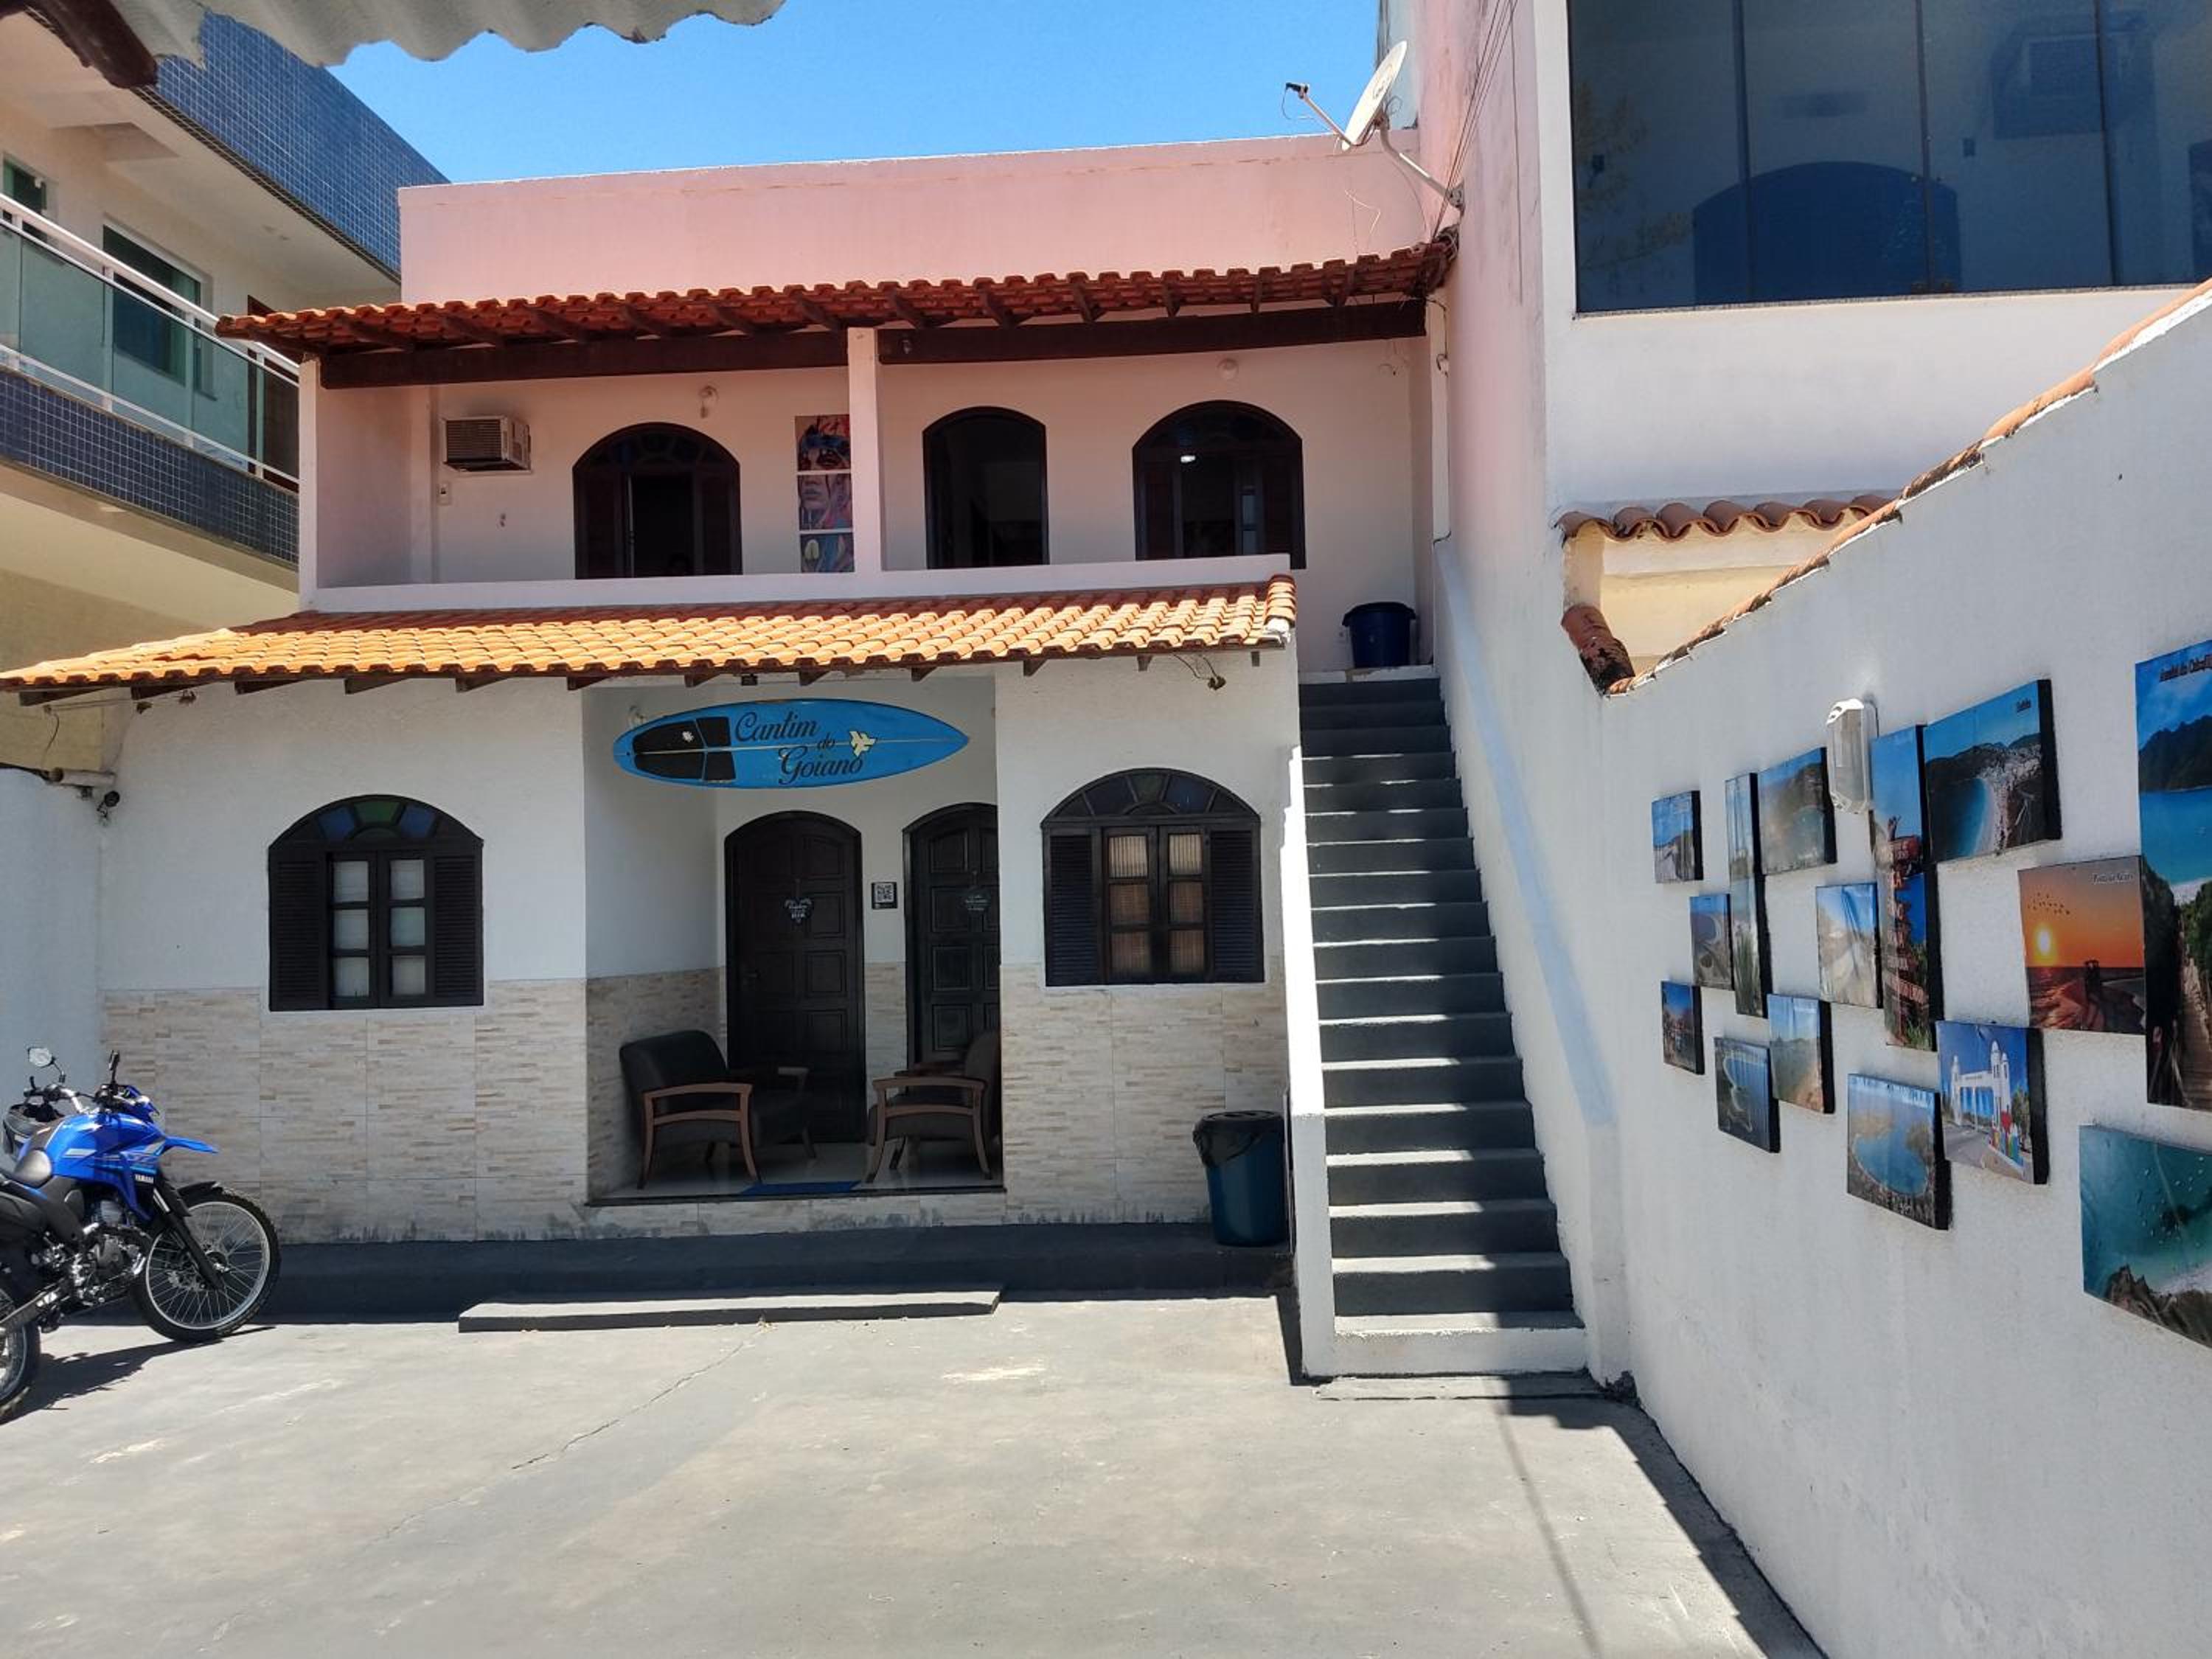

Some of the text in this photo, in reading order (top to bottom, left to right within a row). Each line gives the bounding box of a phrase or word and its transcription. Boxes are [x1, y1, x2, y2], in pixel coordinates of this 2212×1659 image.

[736, 711, 818, 742] Cantim
[817, 732, 836, 750] do
[778, 745, 864, 785] Goiano
